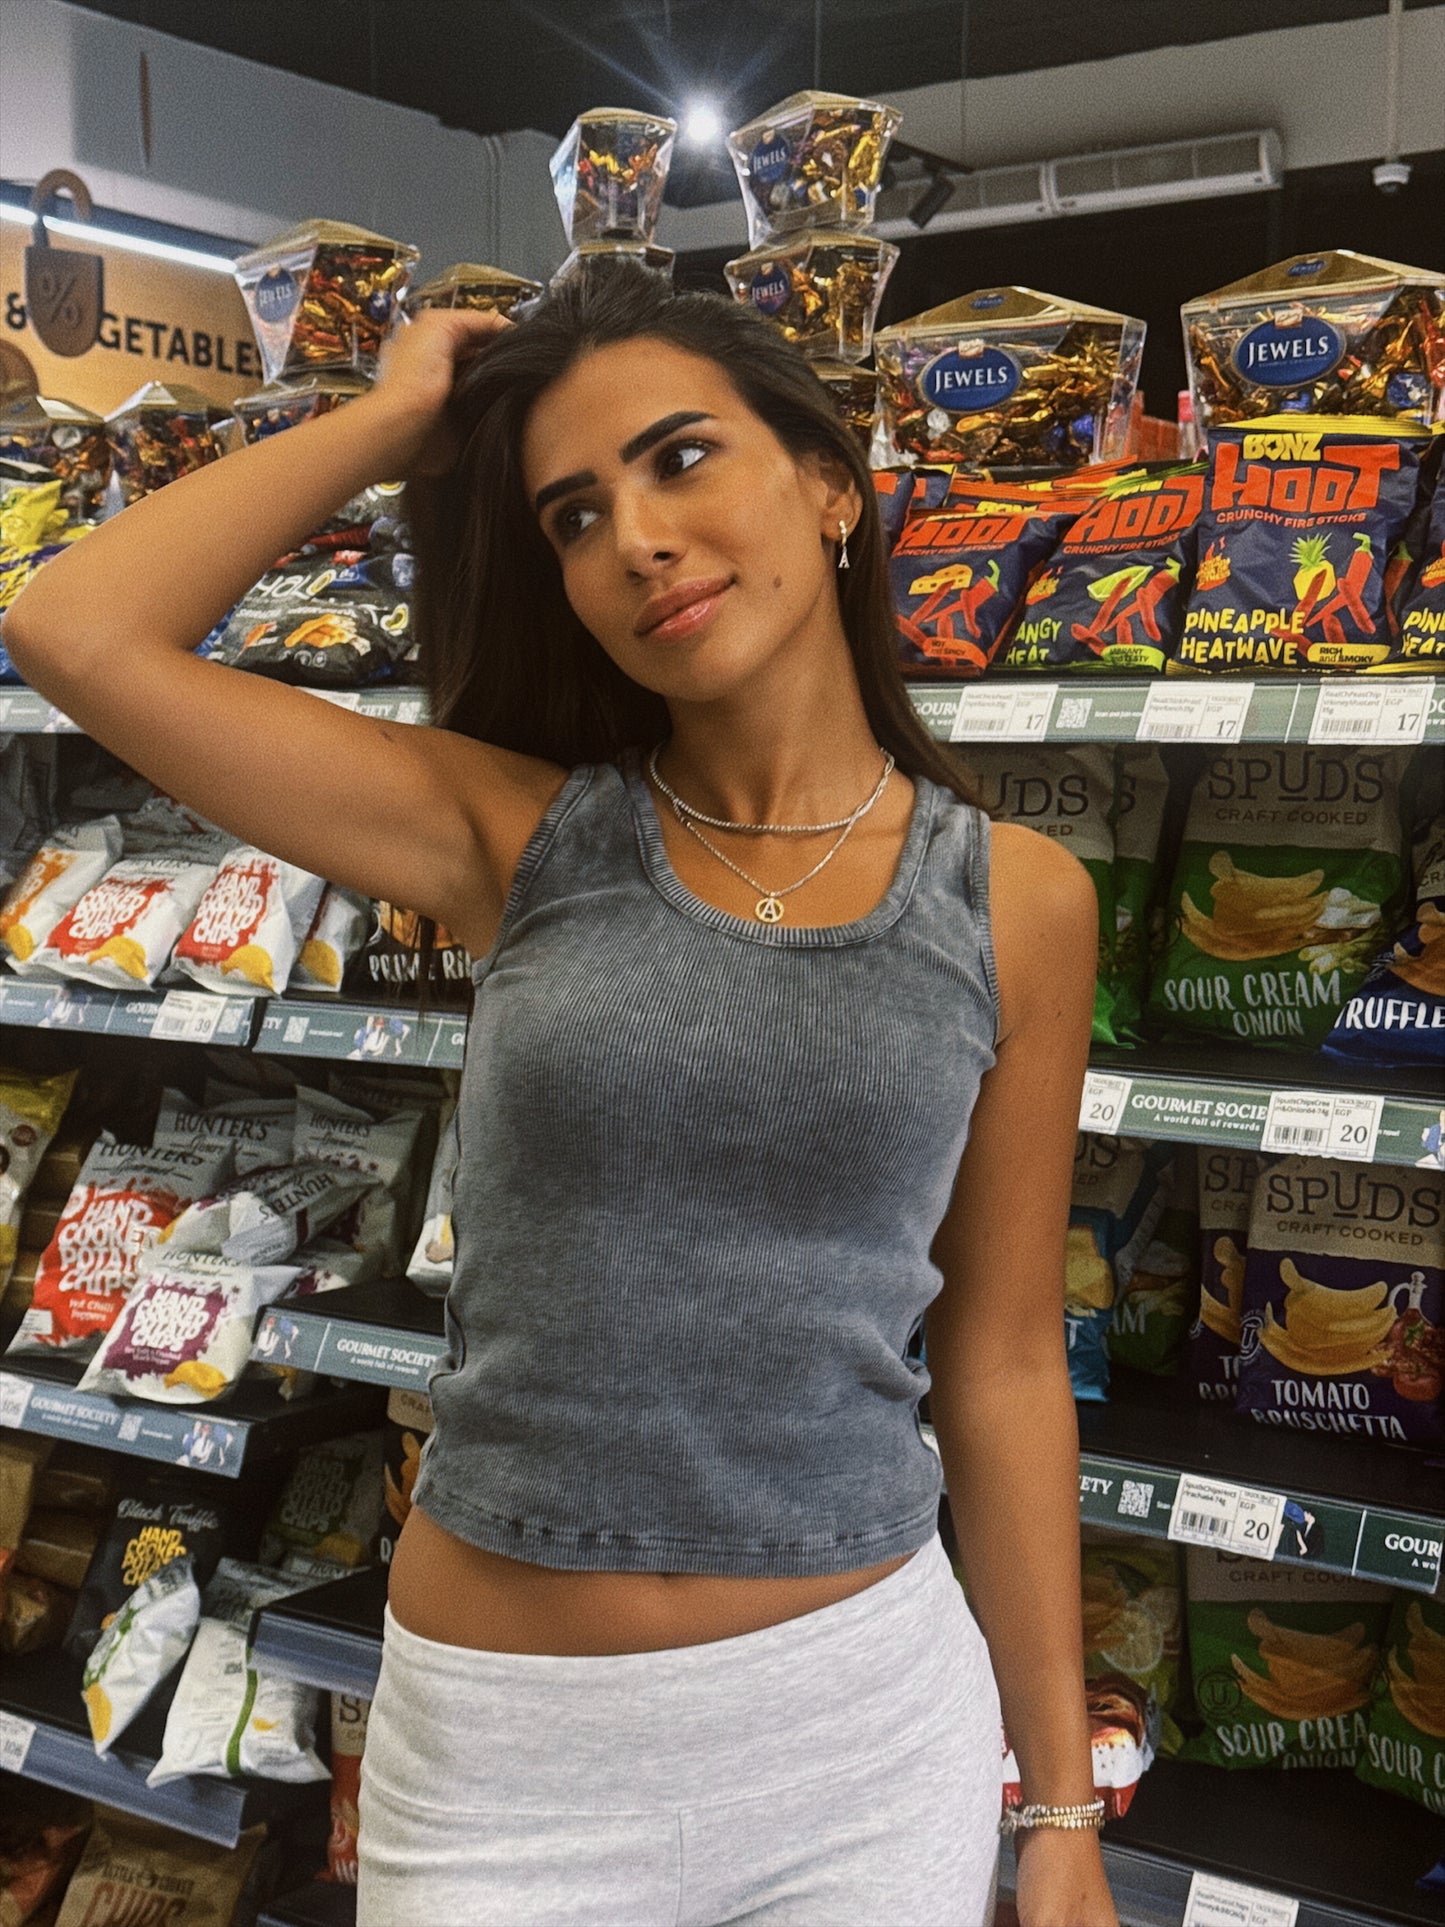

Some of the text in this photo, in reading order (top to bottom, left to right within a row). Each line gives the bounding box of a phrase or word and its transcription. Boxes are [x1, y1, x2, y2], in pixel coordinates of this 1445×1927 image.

[753, 148, 786, 171] JEWELS
[751, 279, 785, 300] JEWELS
[99, 311, 264, 378] GETABLE
[1247, 336, 1329, 369] JEWELS
[934, 366, 1008, 394] JEWELS
[1243, 433, 1323, 461] BONZ
[1211, 442, 1400, 514] HOOT
[1063, 475, 1205, 544] HOOT
[1216, 509, 1367, 529] CRUNCHY FIRE STICKS
[895, 514, 1028, 552] HOOT
[1063, 543, 1120, 555] CRUNCHY
[1015, 617, 1062, 645] ANGY
[1185, 607, 1305, 635] PINEAPPLE
[1180, 636, 1299, 665] HEATWAVE
[1319, 647, 1343, 655] RICH
[1338, 655, 1374, 663] SMOKY
[1025, 714, 1044, 730] 17
[1216, 720, 1237, 737] 17
[1398, 713, 1420, 731] 17
[1208, 751, 1385, 804] SPUDS
[974, 771, 1089, 817] UDS
[1215, 807, 1368, 826] CRAFT COOKED
[1164, 970, 1342, 1012] SOUR CREAM
[1232, 1008, 1305, 1037] ONION
[1089, 1103, 1115, 1122] 20
[1131, 1094, 1268, 1121] GOURMET SOCIE
[1334, 1108, 1352, 1117] EGP
[1153, 1113, 1260, 1132] A world full of rewards
[1340, 1124, 1368, 1144] 20
[80, 1199, 154, 1226] HAND
[1266, 1170, 1442, 1229] SPUDS
[1276, 1219, 1424, 1247] CRAFT COOKED
[337, 1338, 392, 1359] GOURMET
[1270, 1379, 1370, 1411] TOMATO
[1240, 1501, 1256, 1511] EGP
[139, 1526, 182, 1545] HAND
[1243, 1519, 1270, 1541] 20
[1384, 1533, 1442, 1558] GOUR
[1229, 1570, 1295, 1584] CRAFT
[1216, 1711, 1369, 1758] SOUR CREA
[1368, 1732, 1425, 1784] SOUR
